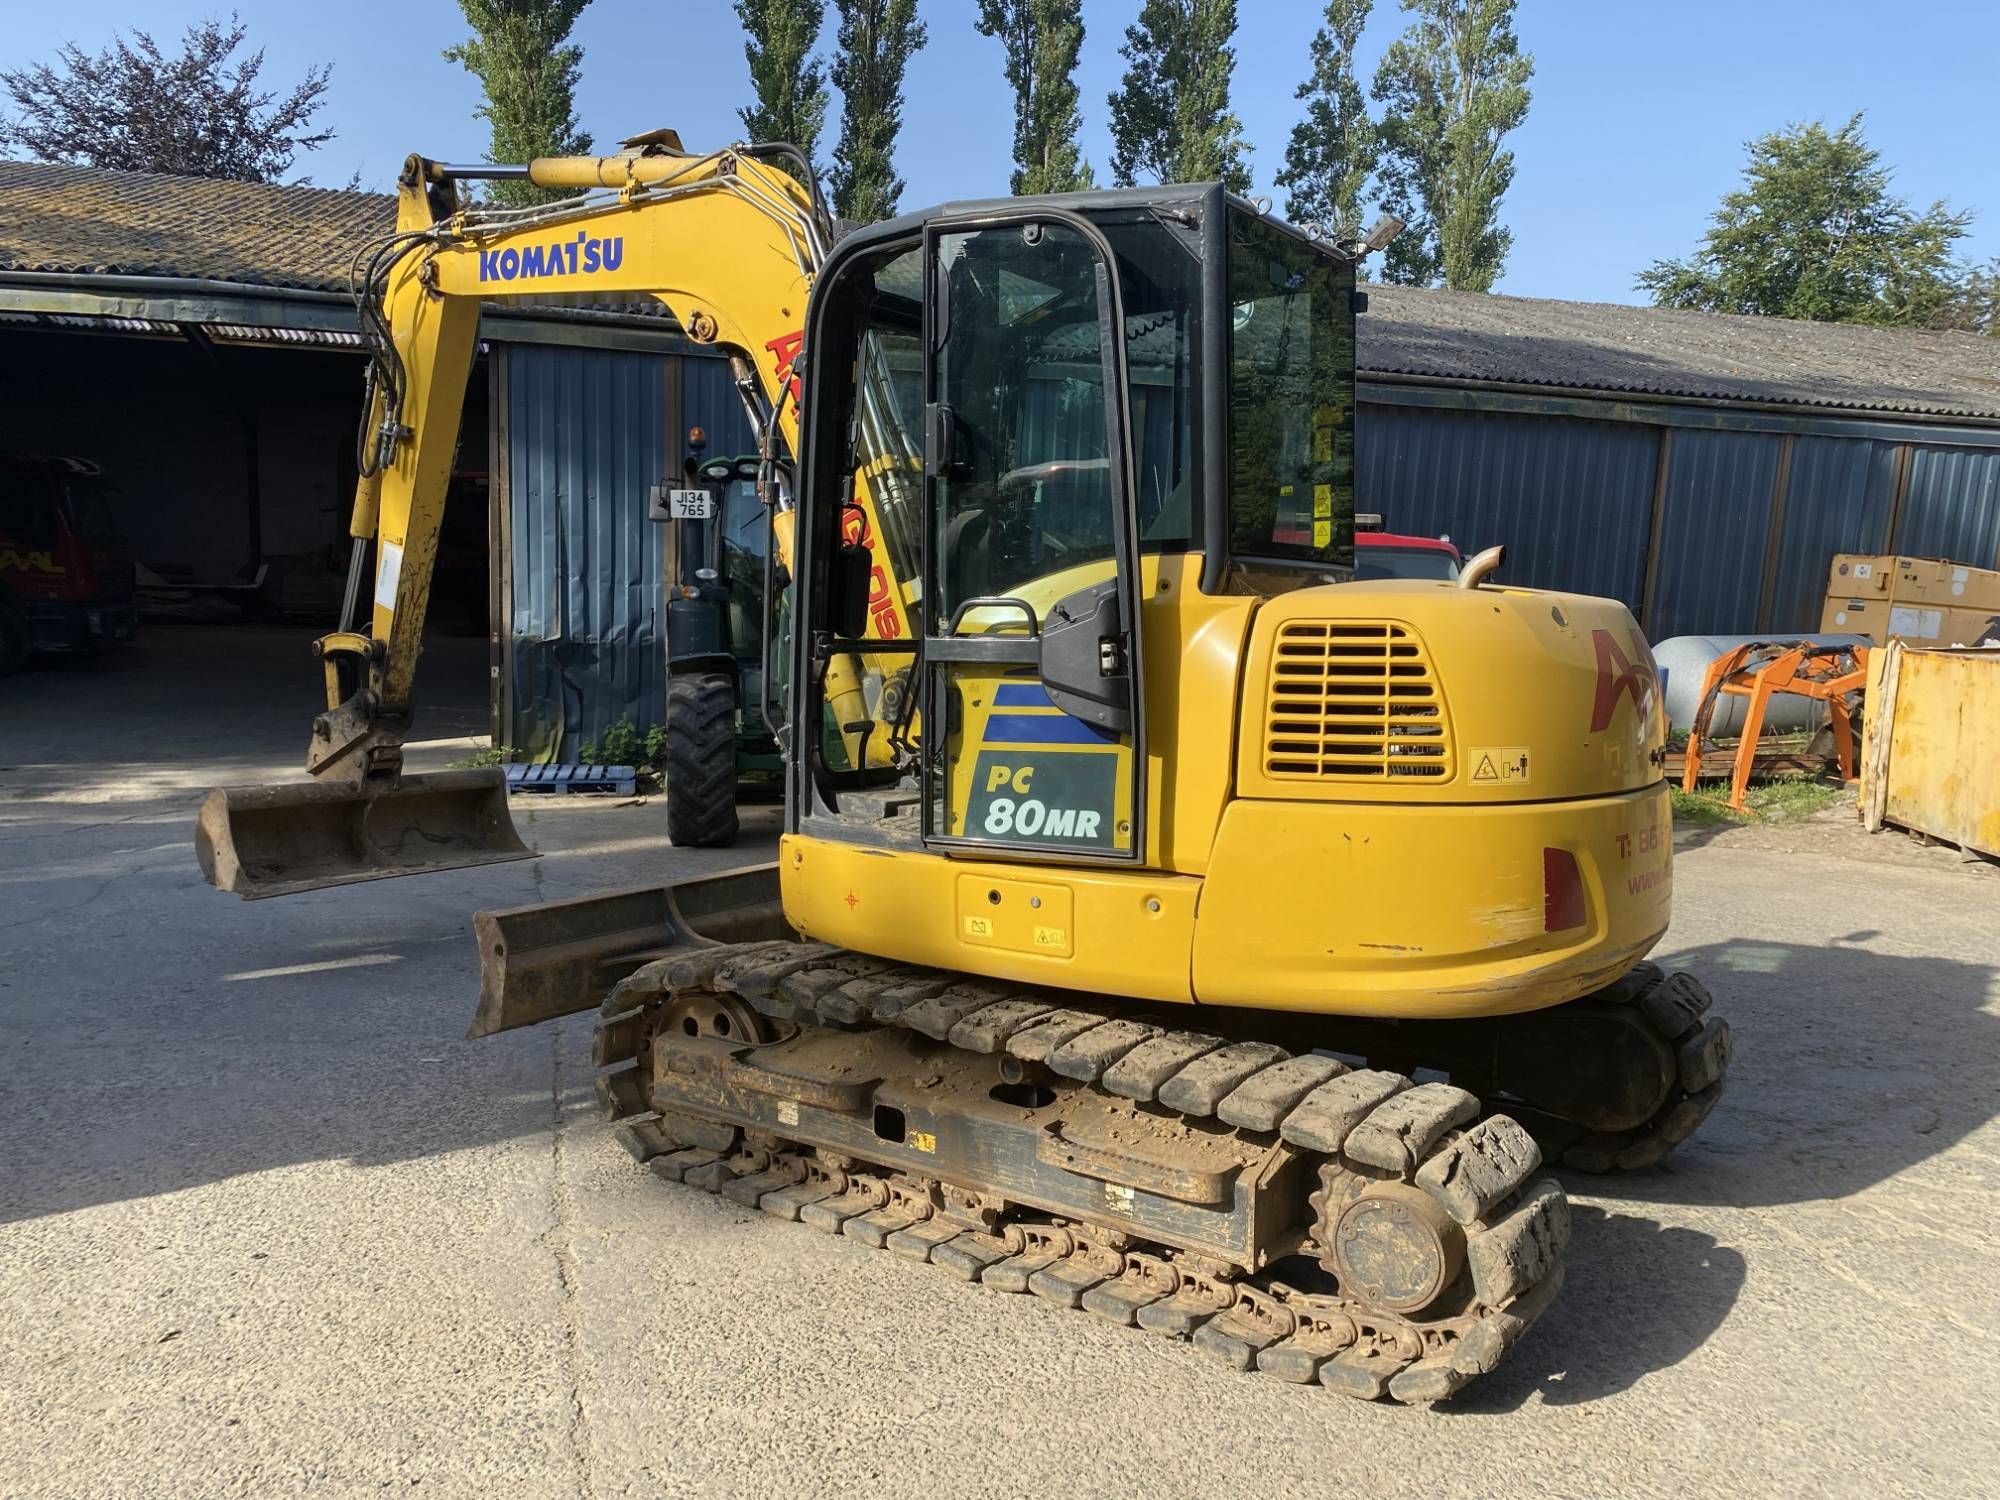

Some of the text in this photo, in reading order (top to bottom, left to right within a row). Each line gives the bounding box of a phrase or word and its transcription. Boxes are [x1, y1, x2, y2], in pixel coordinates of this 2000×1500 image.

[479, 231, 624, 282] KOMATSU
[676, 492, 704, 503] J134
[681, 504, 705, 516] 765
[986, 765, 1035, 794] PC
[984, 798, 1101, 838] 80MR
